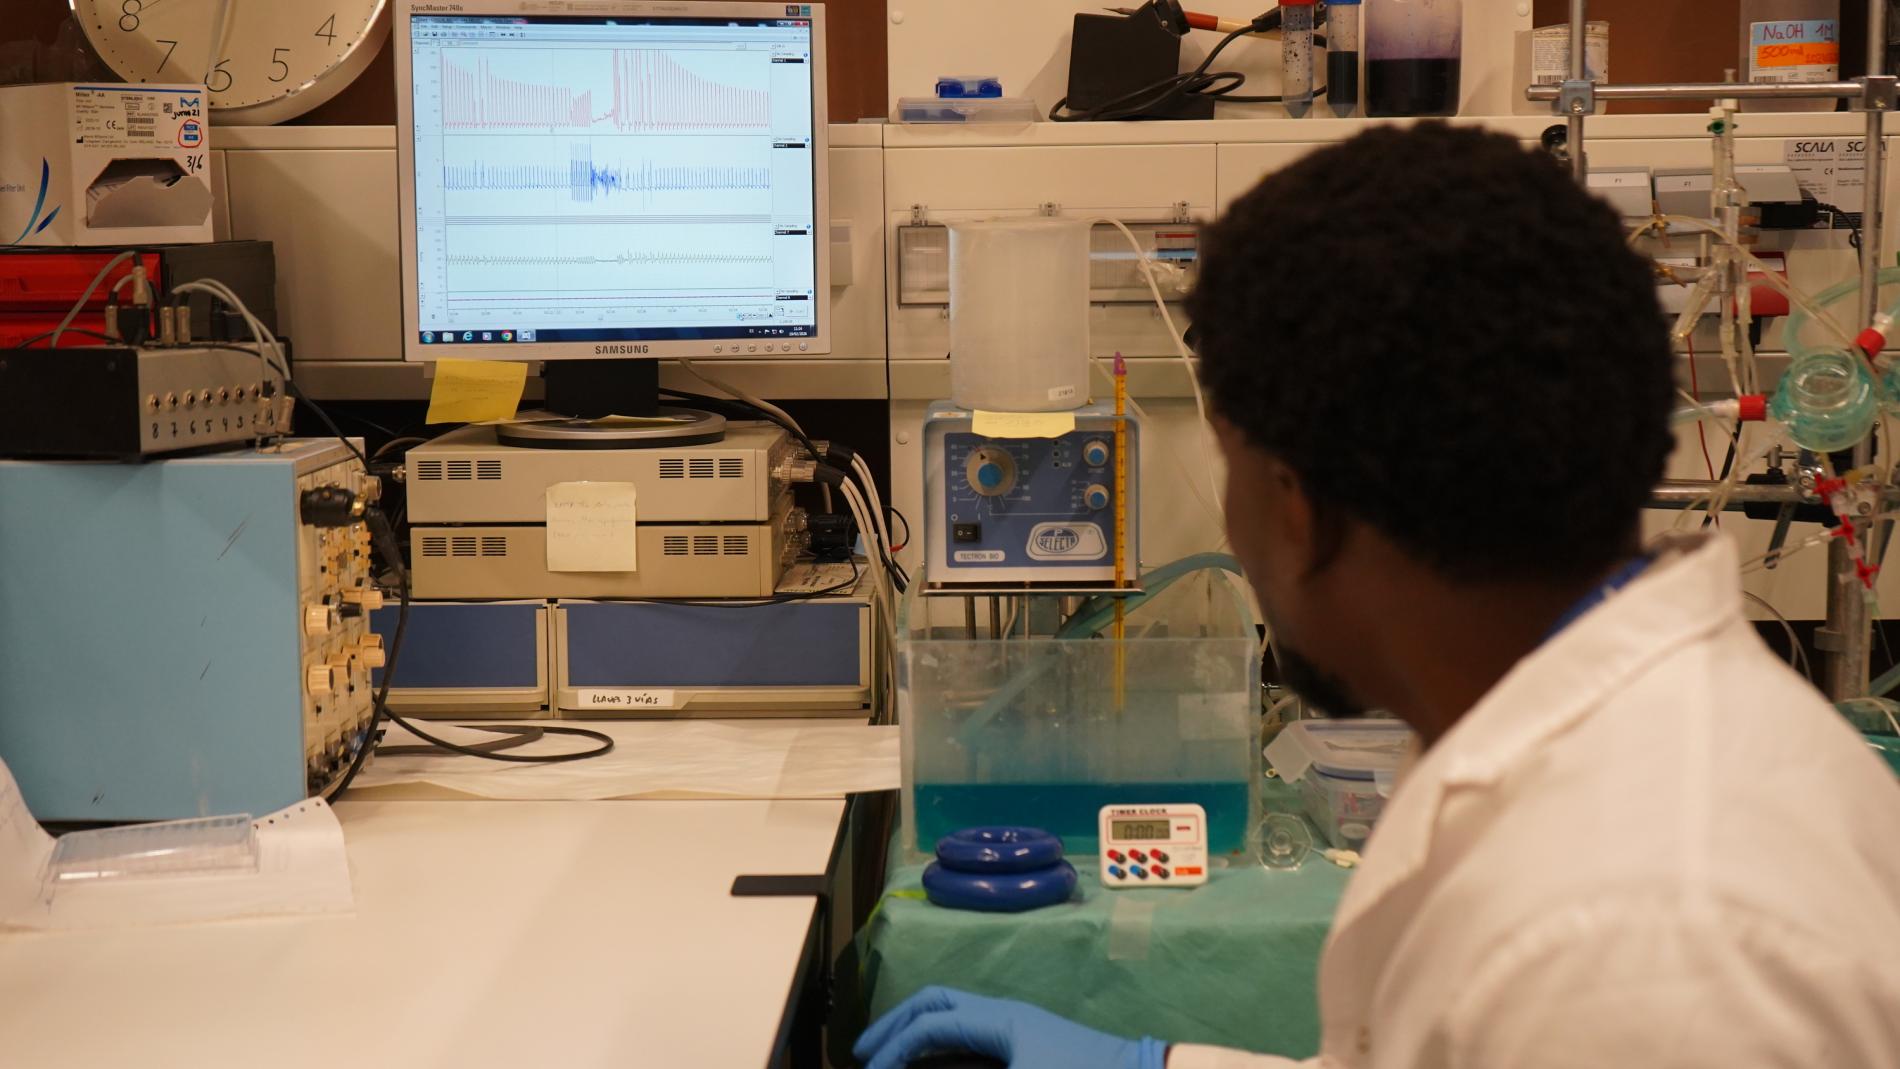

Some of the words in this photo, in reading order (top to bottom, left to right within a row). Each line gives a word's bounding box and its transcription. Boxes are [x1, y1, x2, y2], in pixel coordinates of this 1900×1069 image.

[119, 0, 142, 32] 8
[411, 4, 448, 12] SyncMaster
[314, 13, 337, 46] 4
[1763, 23, 1804, 41] NaOH
[156, 39, 178, 74] 7
[267, 48, 290, 82] 5
[204, 58, 232, 92] 6
[1794, 142, 1835, 153] SCALA
[595, 345, 649, 355] SAMSUNG
[152, 421, 159, 439] 8
[170, 421, 179, 437] 7
[190, 420, 197, 435] 6
[205, 419, 213, 433] 5
[222, 415, 229, 432] 4
[236, 415, 244, 429] 3
[960, 552, 987, 560] TECTRON
[989, 552, 1000, 560] BIO
[626, 695, 632, 704] 3
